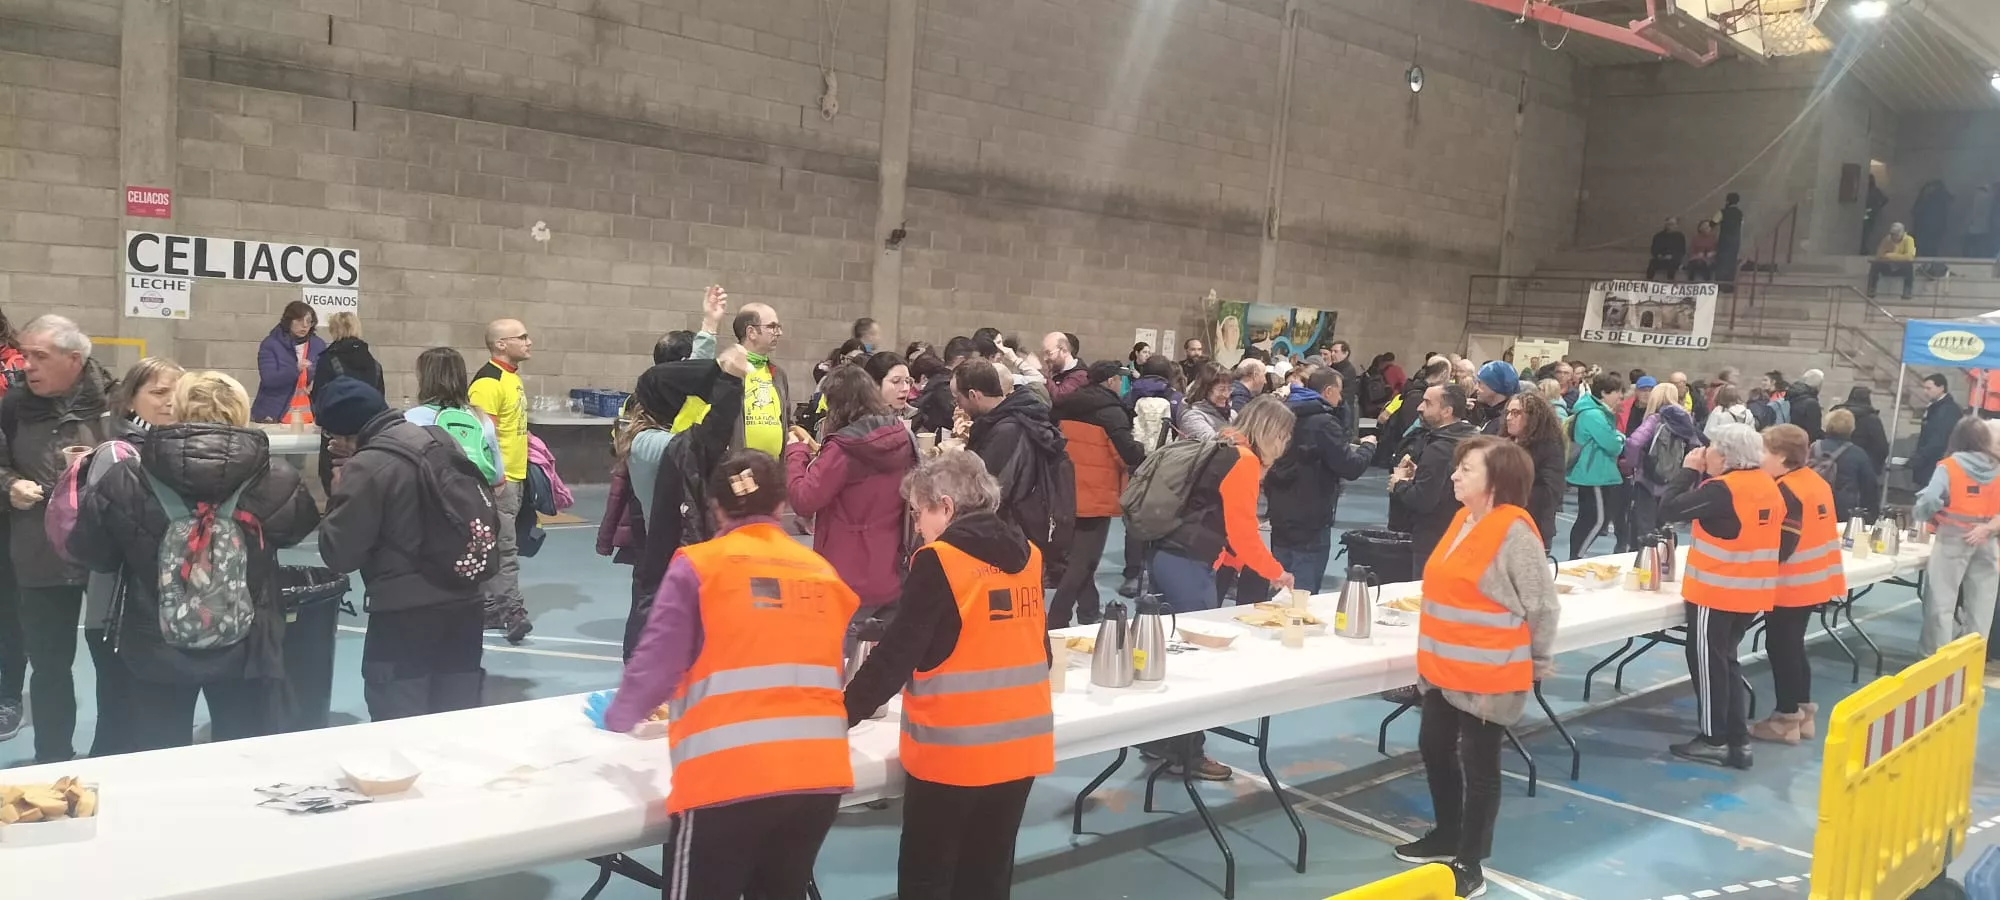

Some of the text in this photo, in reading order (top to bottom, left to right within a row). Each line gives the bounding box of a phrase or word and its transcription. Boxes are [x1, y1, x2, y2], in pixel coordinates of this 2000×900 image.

[127, 190, 169, 206] CELIACOS
[127, 233, 358, 286] CELIACOS
[131, 277, 187, 291] LECHE
[1652, 284, 1667, 295] DE
[1671, 285, 1716, 296] CASBAS
[305, 295, 357, 307] VEGANOS
[1584, 329, 1708, 347] ES DEL PUEBLO
